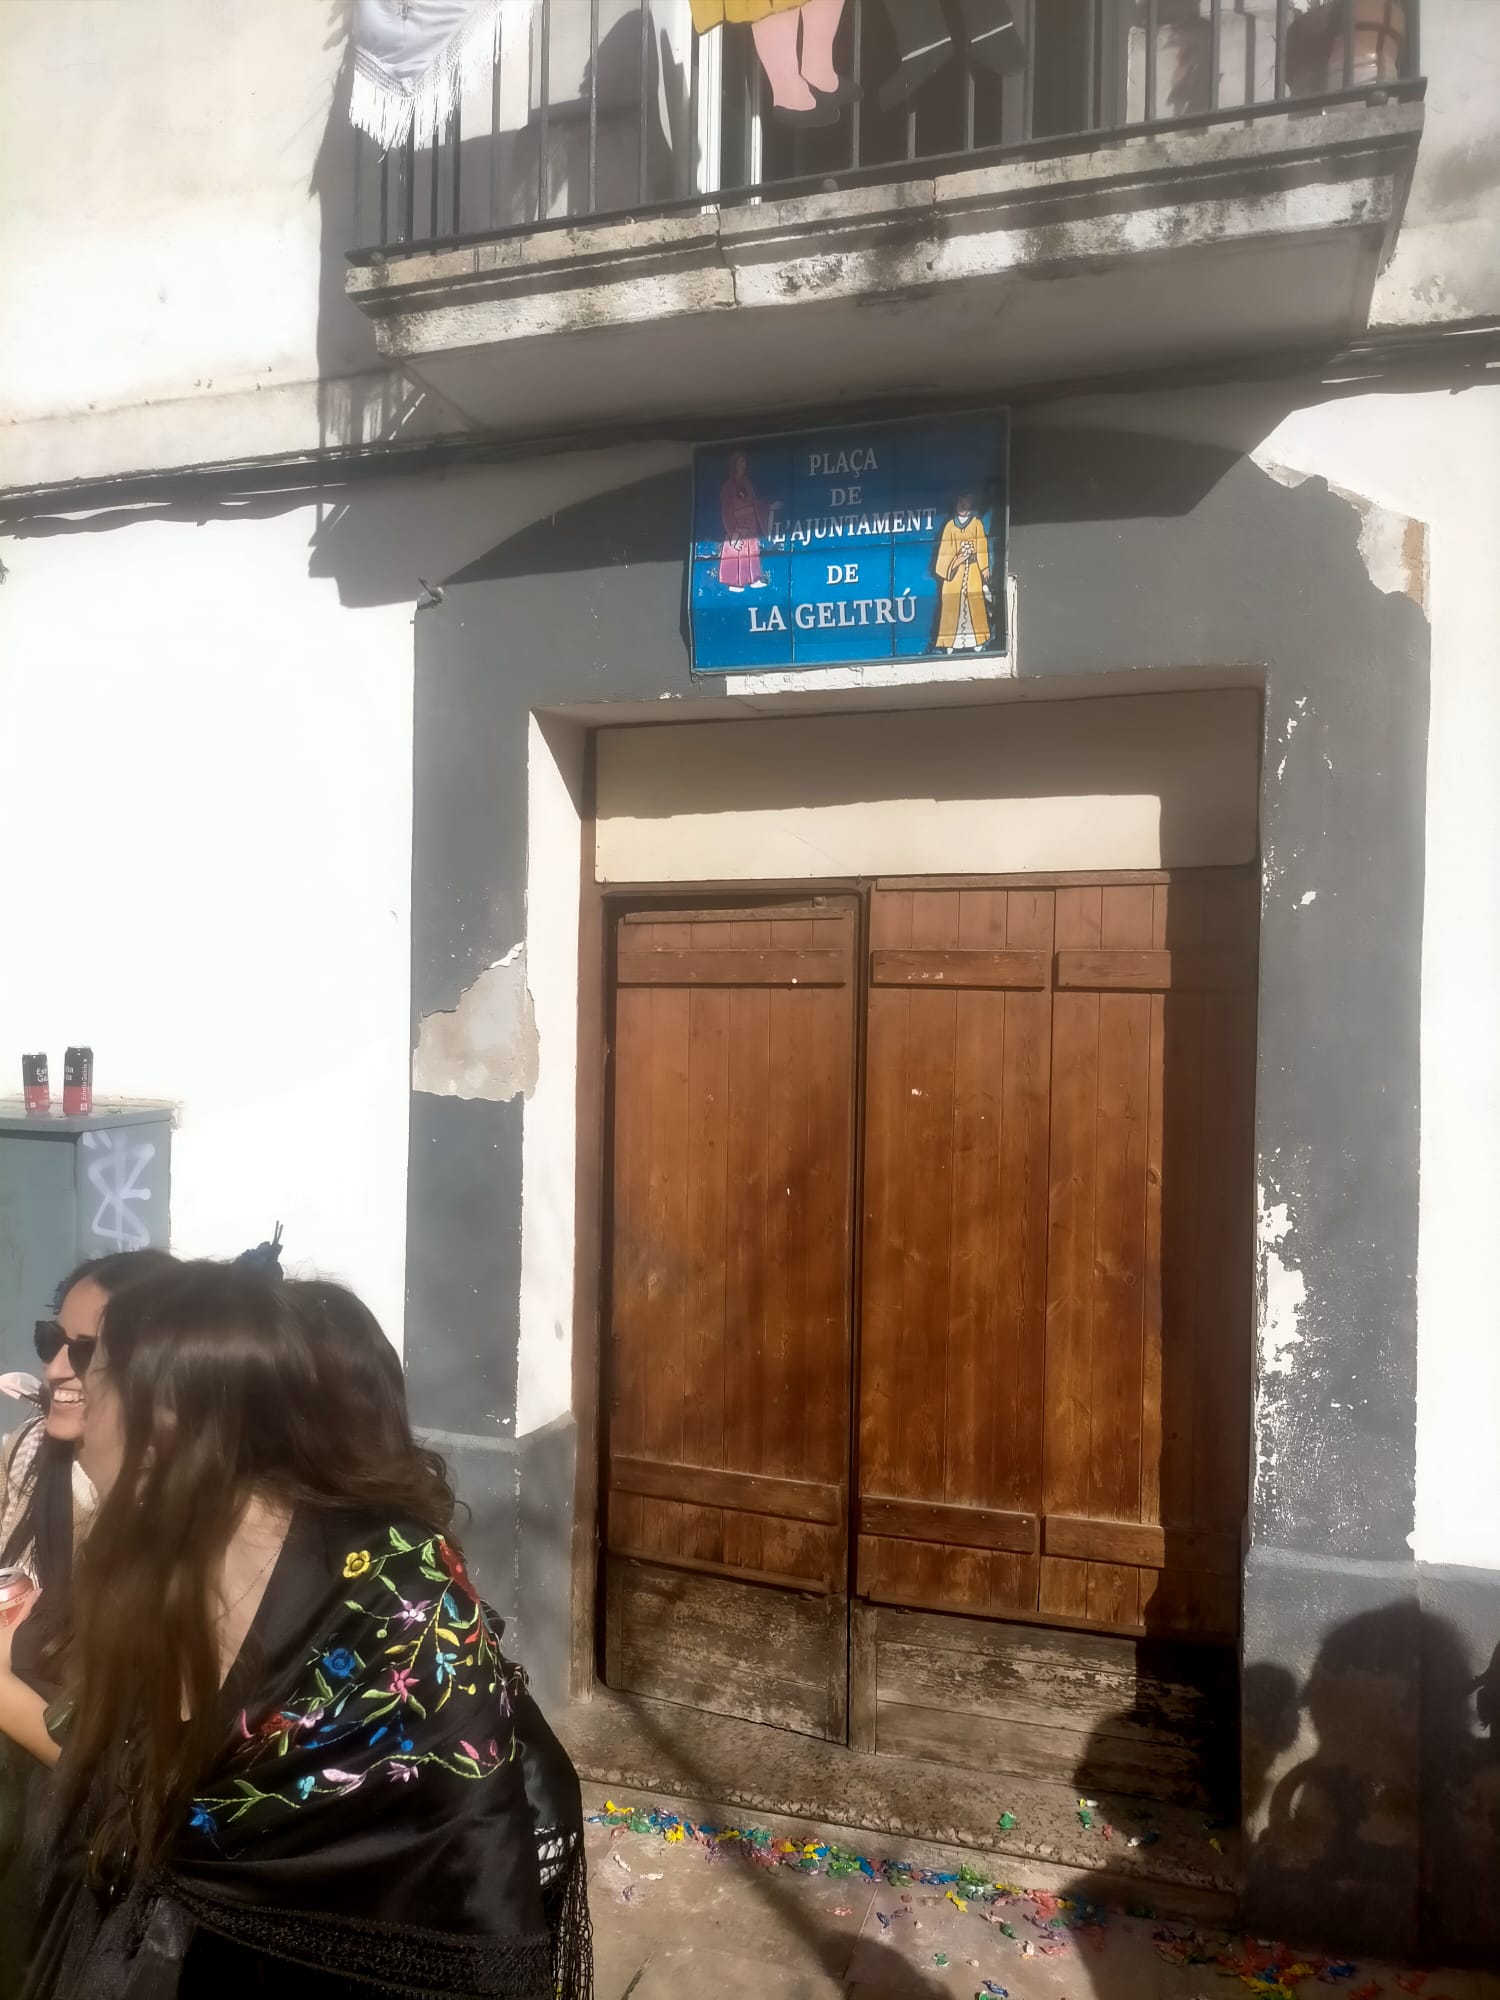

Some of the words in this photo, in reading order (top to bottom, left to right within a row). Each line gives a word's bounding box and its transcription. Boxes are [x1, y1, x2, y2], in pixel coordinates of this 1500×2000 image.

[809, 448, 878, 478] PLAÇA
[830, 486, 862, 507] DE
[773, 508, 936, 546] L'AJUNTAMENT
[826, 564, 859, 585] DE
[748, 605, 787, 632] LA
[795, 587, 917, 630] GELTRÚ
